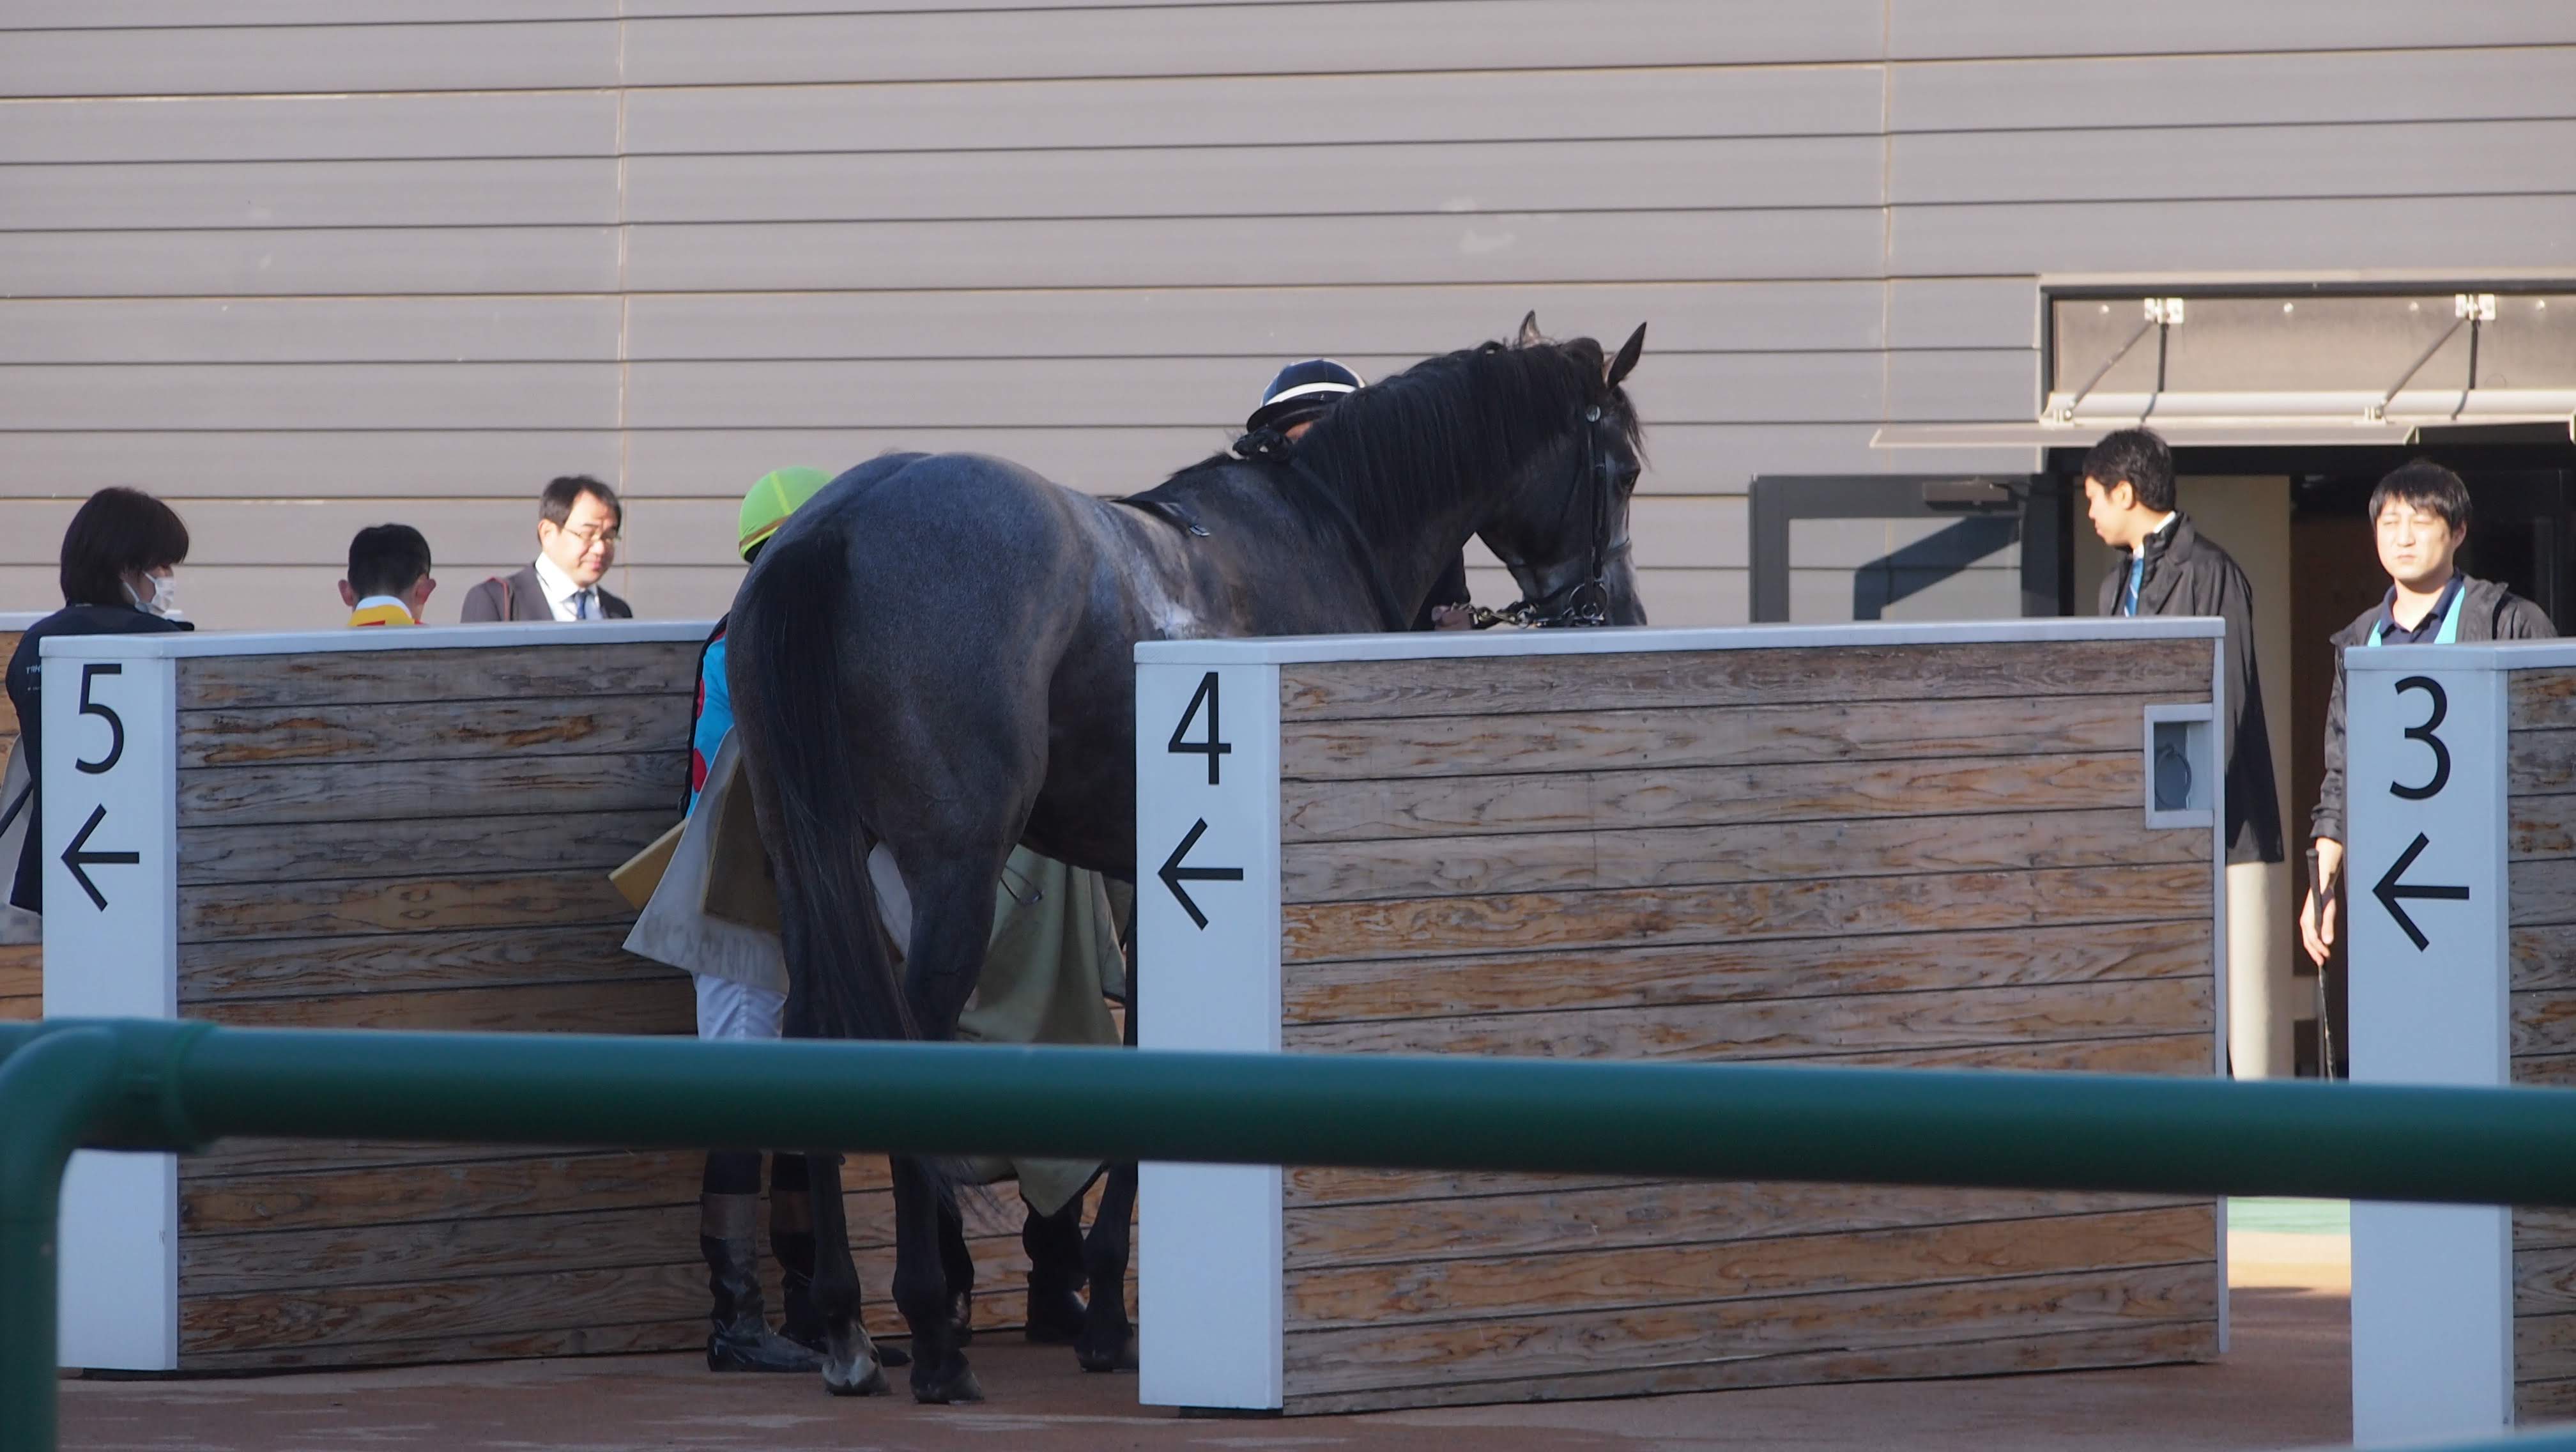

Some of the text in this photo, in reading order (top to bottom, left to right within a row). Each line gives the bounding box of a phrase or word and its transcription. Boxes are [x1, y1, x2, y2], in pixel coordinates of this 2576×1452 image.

[75, 663, 125, 775] 5
[1168, 671, 1232, 785] 4
[2389, 676, 2451, 801] 3
